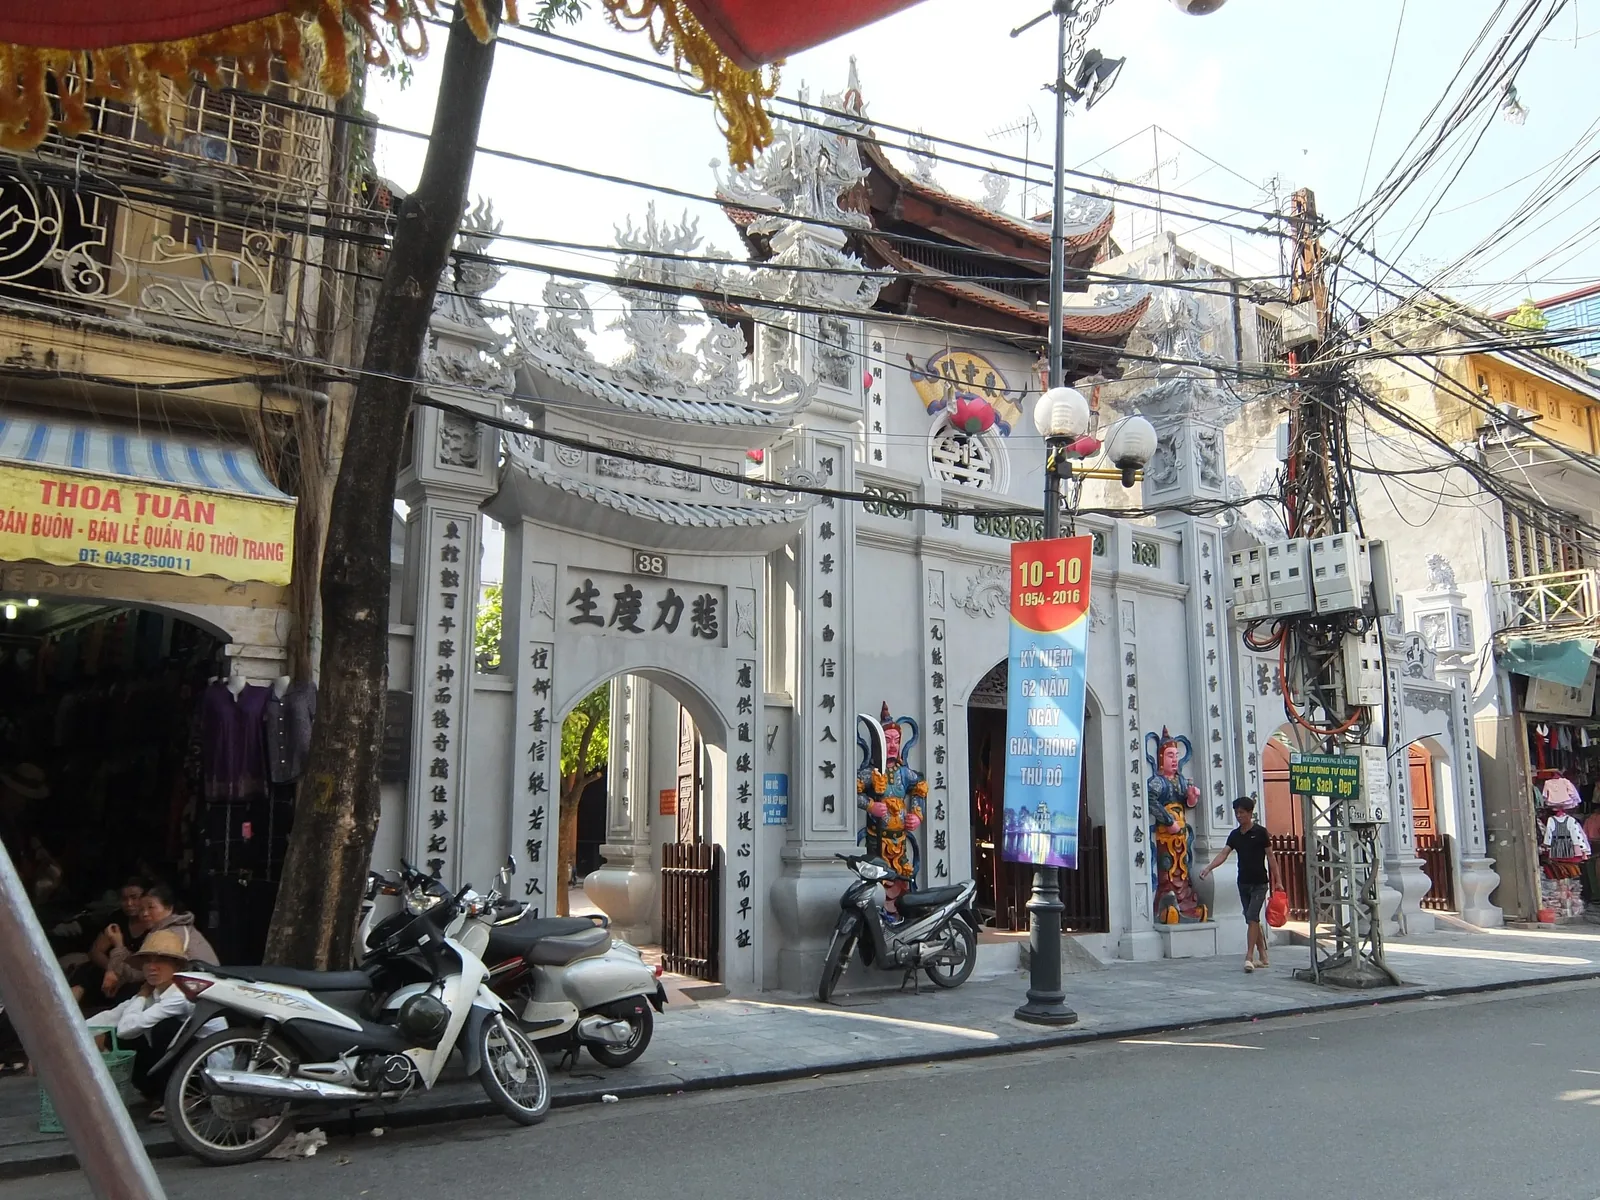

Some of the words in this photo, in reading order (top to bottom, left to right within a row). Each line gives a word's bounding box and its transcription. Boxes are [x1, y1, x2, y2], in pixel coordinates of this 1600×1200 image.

[40, 480, 121, 514] THOA
[0, 506, 28, 534] BÁN
[32, 512, 73, 539] BUÔN
[88, 516, 119, 543] BÁN
[123, 517, 140, 545] LẺ
[186, 527, 205, 552] ÁO
[209, 531, 238, 557] THỜI
[242, 538, 284, 562] TRANG
[79, 548, 100, 563] ĐT:
[105, 550, 191, 571] 0438250011
[638, 555, 664, 574] 38
[1020, 641, 1036, 668] KỶ
[1039, 645, 1073, 671] NIỆM
[1021, 679, 1037, 698] 62
[1039, 674, 1070, 697] NĂM
[1027, 704, 1061, 727] NGÀY
[1010, 730, 1033, 756] GIẢI
[1035, 734, 1077, 757] PHÓNG
[1020, 760, 1043, 786] THỦ
[1046, 764, 1062, 787] ĐÔ
